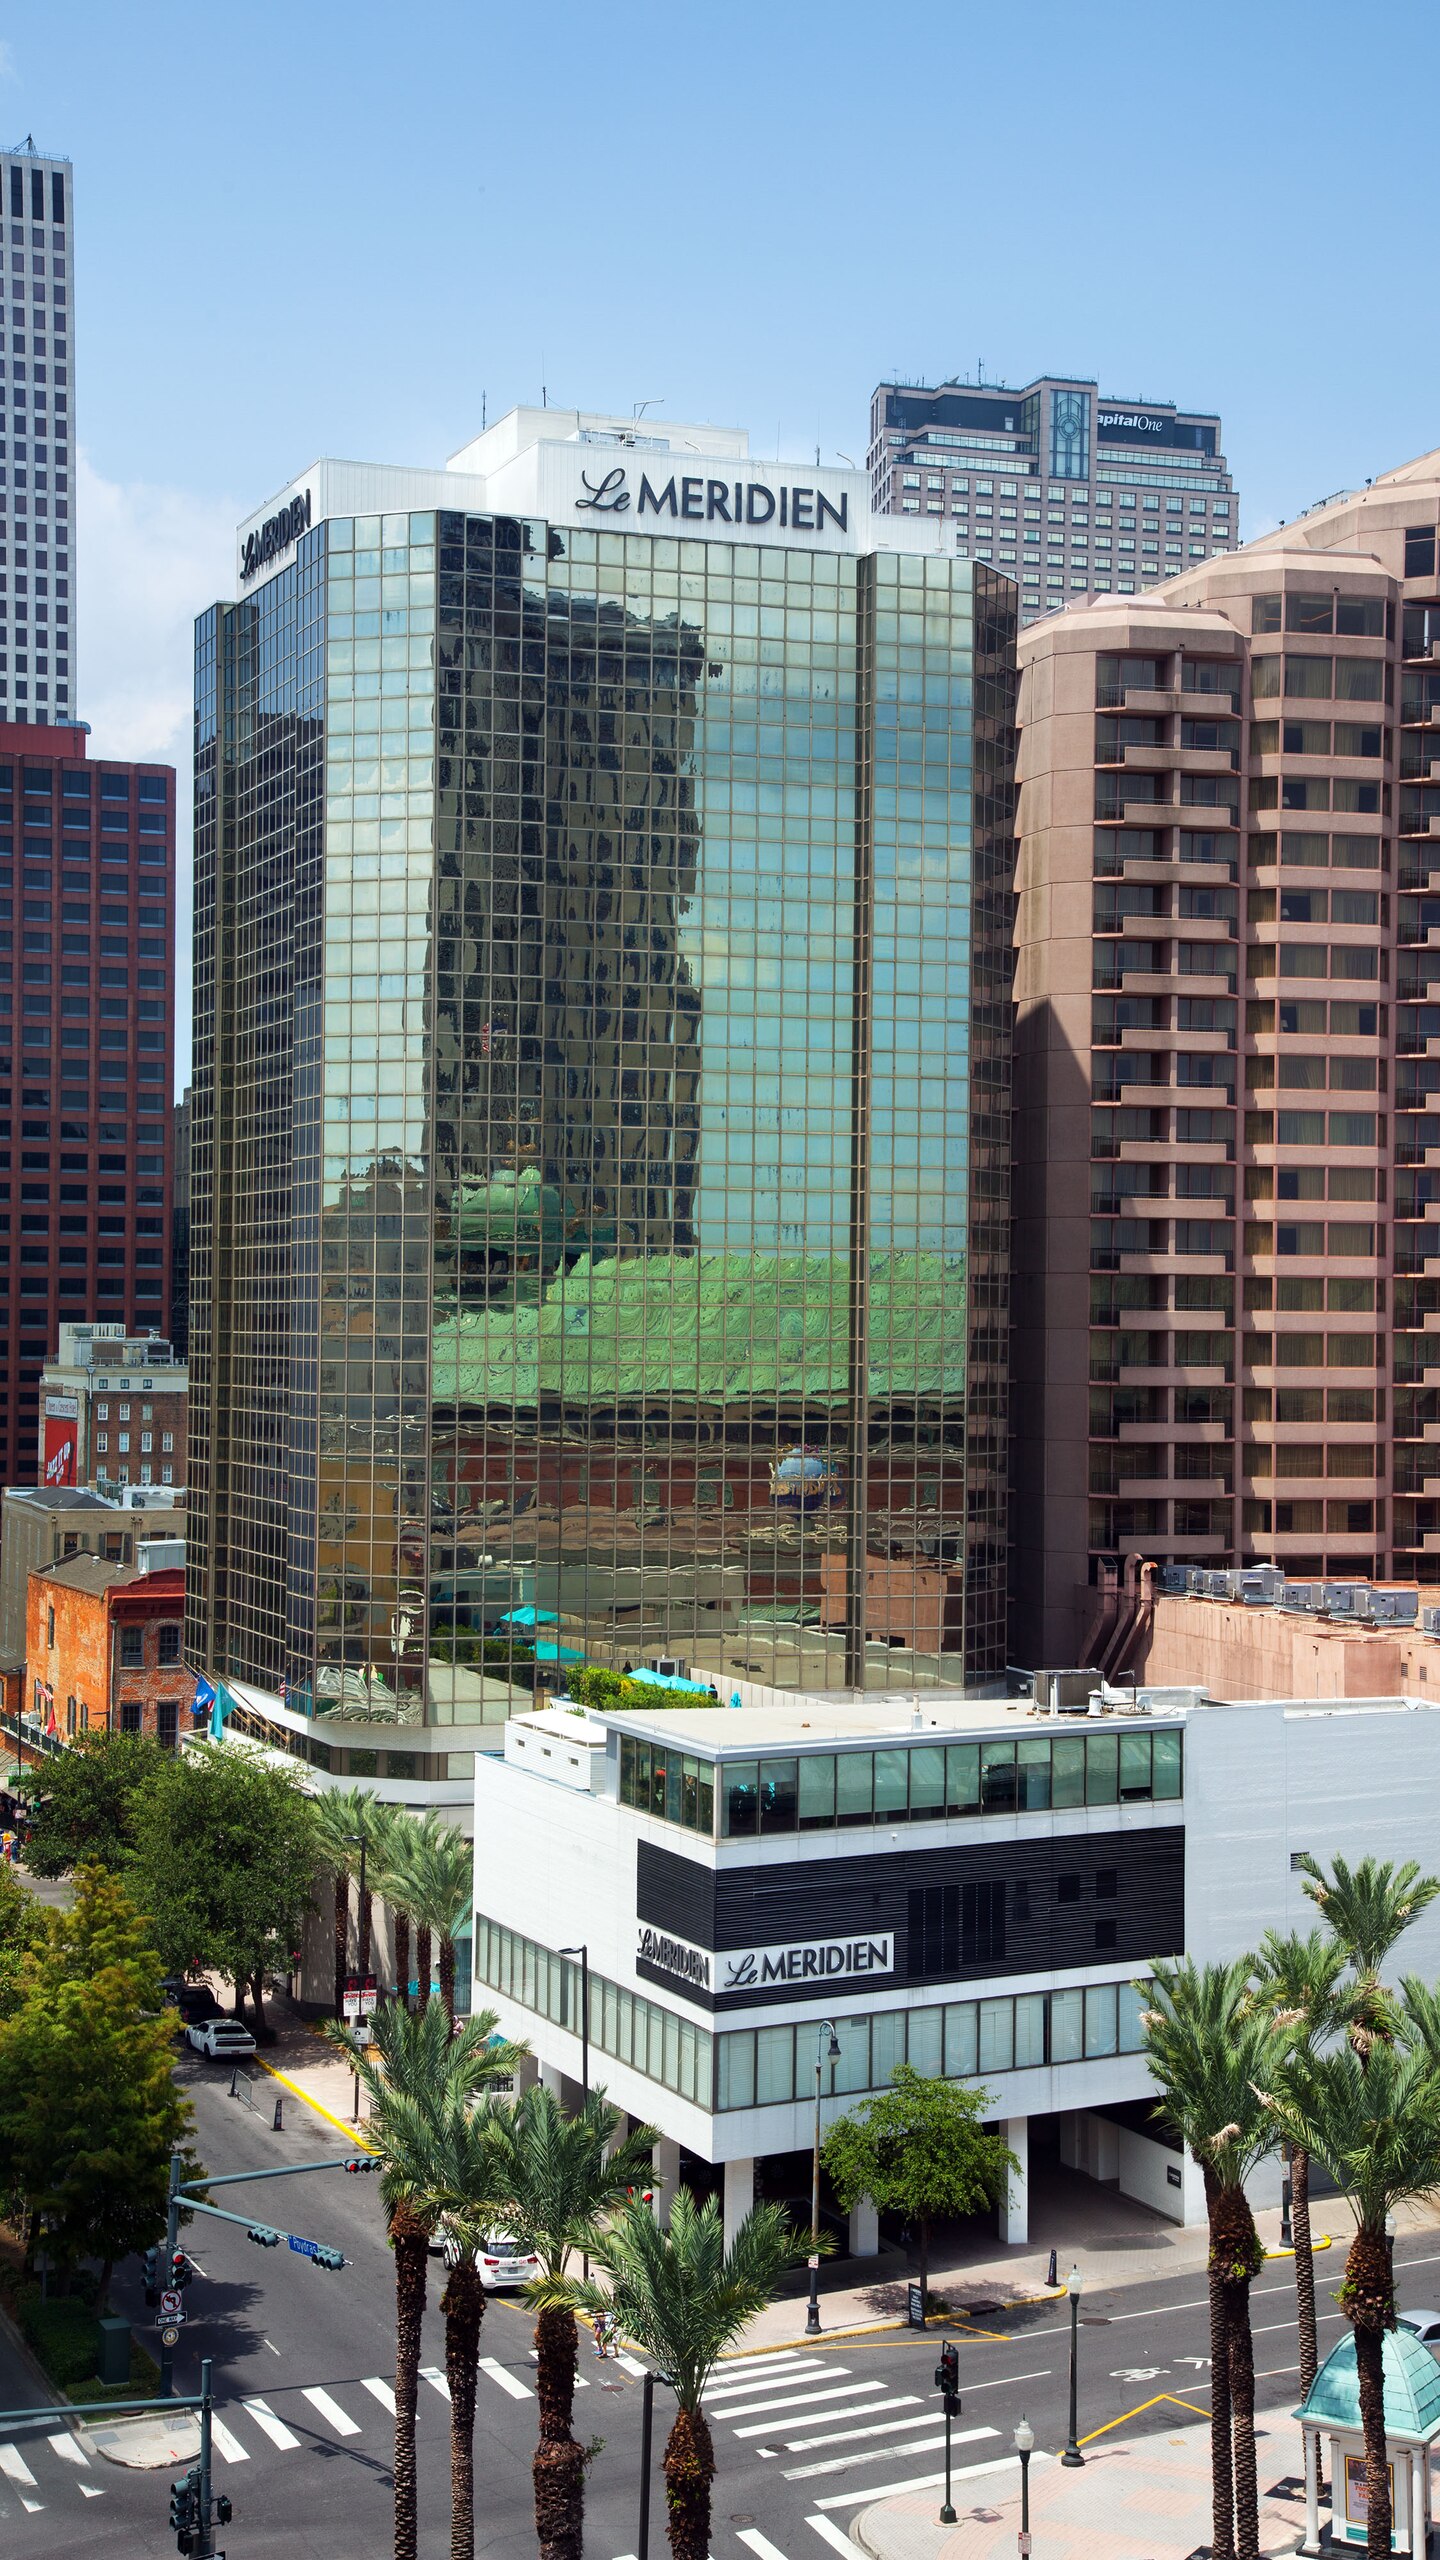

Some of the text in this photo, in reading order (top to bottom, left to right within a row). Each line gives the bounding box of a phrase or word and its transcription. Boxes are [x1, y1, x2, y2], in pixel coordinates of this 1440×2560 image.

[1097, 413, 1163, 432] apitalOne
[575, 467, 848, 533] Le MERIDIEN
[254, 488, 312, 569] MERIDIEN
[636, 1928, 710, 1986] Le MERIDIEN
[724, 1939, 889, 1987] Le MERIDIEN
[292, 2236, 317, 2254] Poydras
